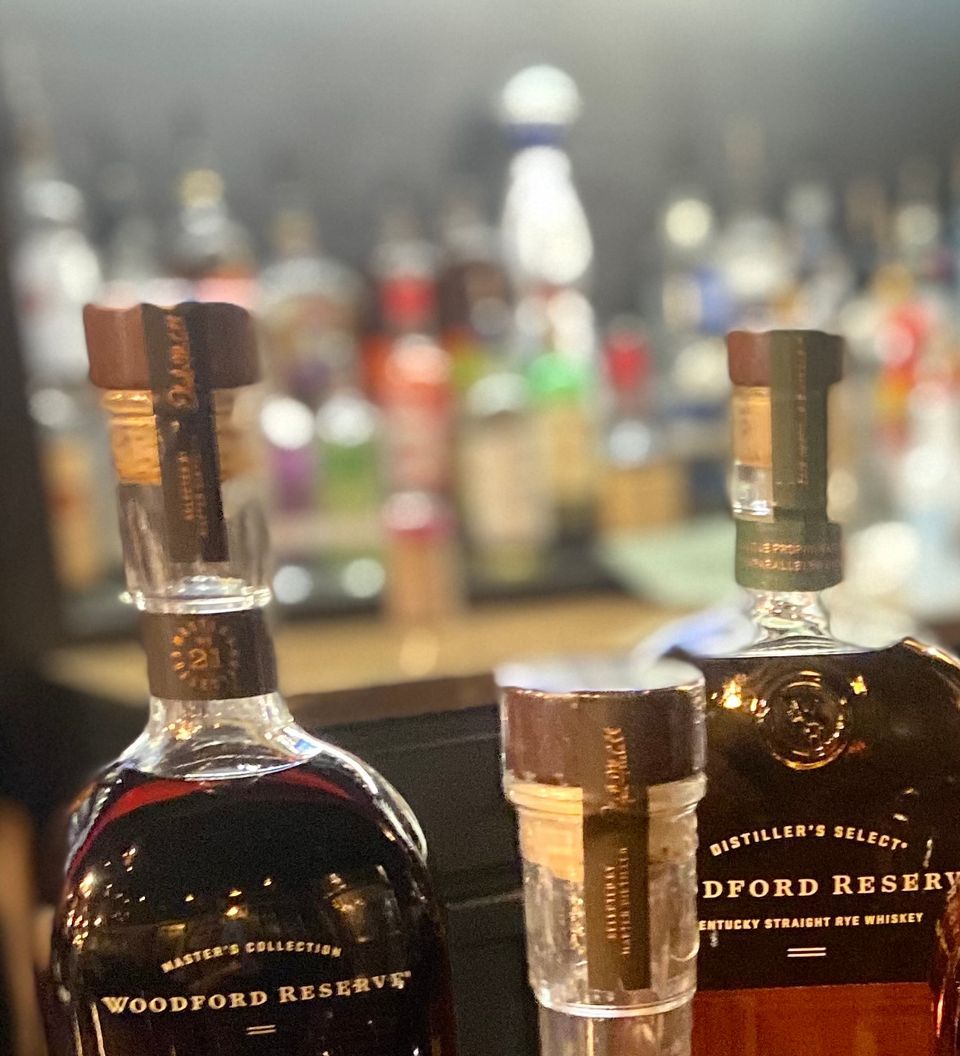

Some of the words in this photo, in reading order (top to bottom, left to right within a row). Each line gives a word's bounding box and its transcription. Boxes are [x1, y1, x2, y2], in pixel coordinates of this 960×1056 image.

[709, 824, 826, 857] DISTILLER'S
[833, 825, 903, 851] SELECT
[702, 878, 820, 900] DFORD
[699, 919, 759, 931] ENTUCKY
[764, 917, 832, 930] STRAIGHT
[834, 915, 860, 928] RYE
[864, 912, 924, 925] WHISKEY
[160, 943, 240, 974] MASTER'S
[245, 941, 342, 958] COLLECTION
[101, 989, 268, 1014] WOODFORD
